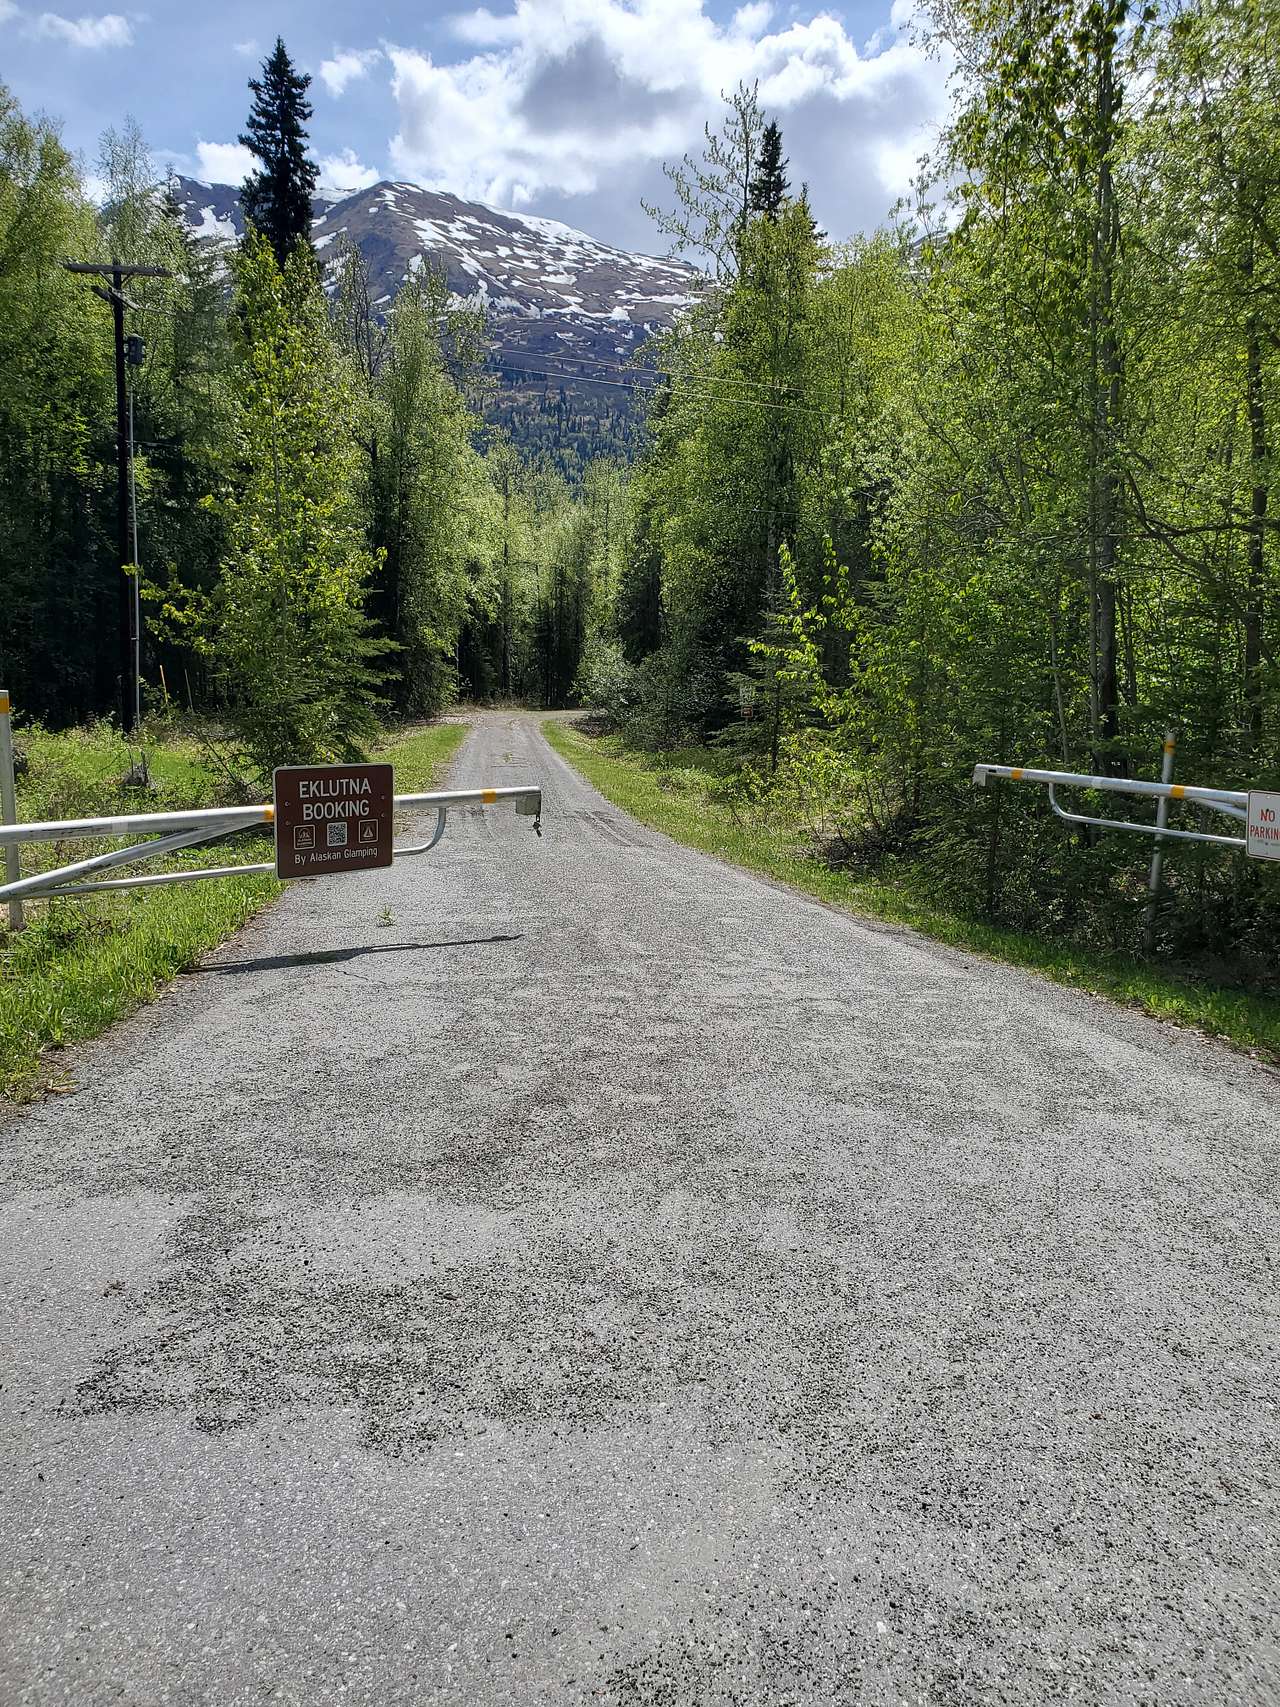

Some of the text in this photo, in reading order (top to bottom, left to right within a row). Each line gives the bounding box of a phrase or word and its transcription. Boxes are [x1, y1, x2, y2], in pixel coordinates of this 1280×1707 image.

[299, 778, 372, 798] EKLUTNA
[303, 800, 370, 820] BOOKING
[1260, 808, 1276, 822] NO
[1250, 825, 1280, 840] PARKIN
[295, 847, 378, 865] By Alaskan Glamping
